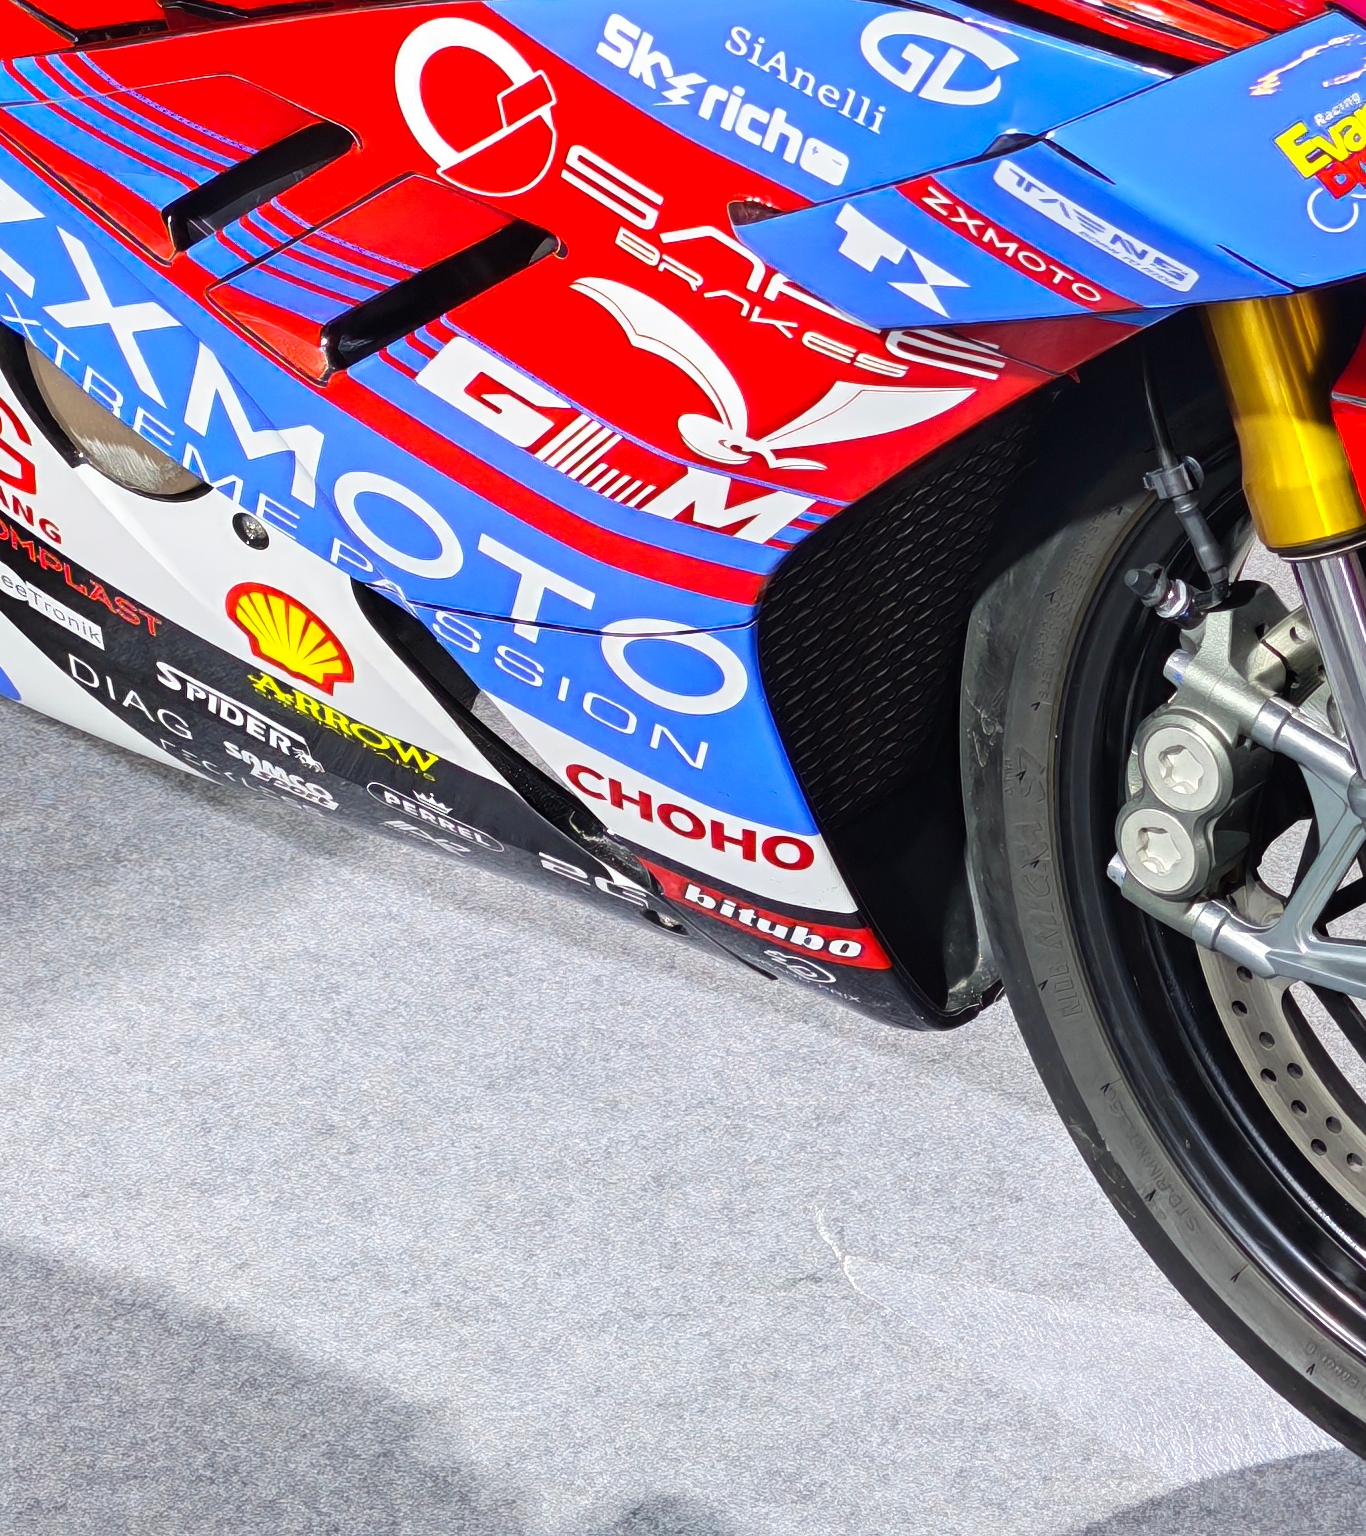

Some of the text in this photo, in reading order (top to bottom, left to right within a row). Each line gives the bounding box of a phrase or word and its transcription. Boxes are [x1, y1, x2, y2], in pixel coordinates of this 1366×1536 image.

[724, 26, 887, 135] SiAnelli
[921, 185, 1102, 302] ZXMOTO
[614, 226, 910, 379] BRAKES
[68, 653, 194, 741] DIAG
[155, 660, 307, 756] SPIDER
[247, 671, 440, 773] ARROW
[384, 790, 493, 847] PERREL
[565, 763, 815, 871] CHOHO
[684, 883, 863, 958] bitubo
